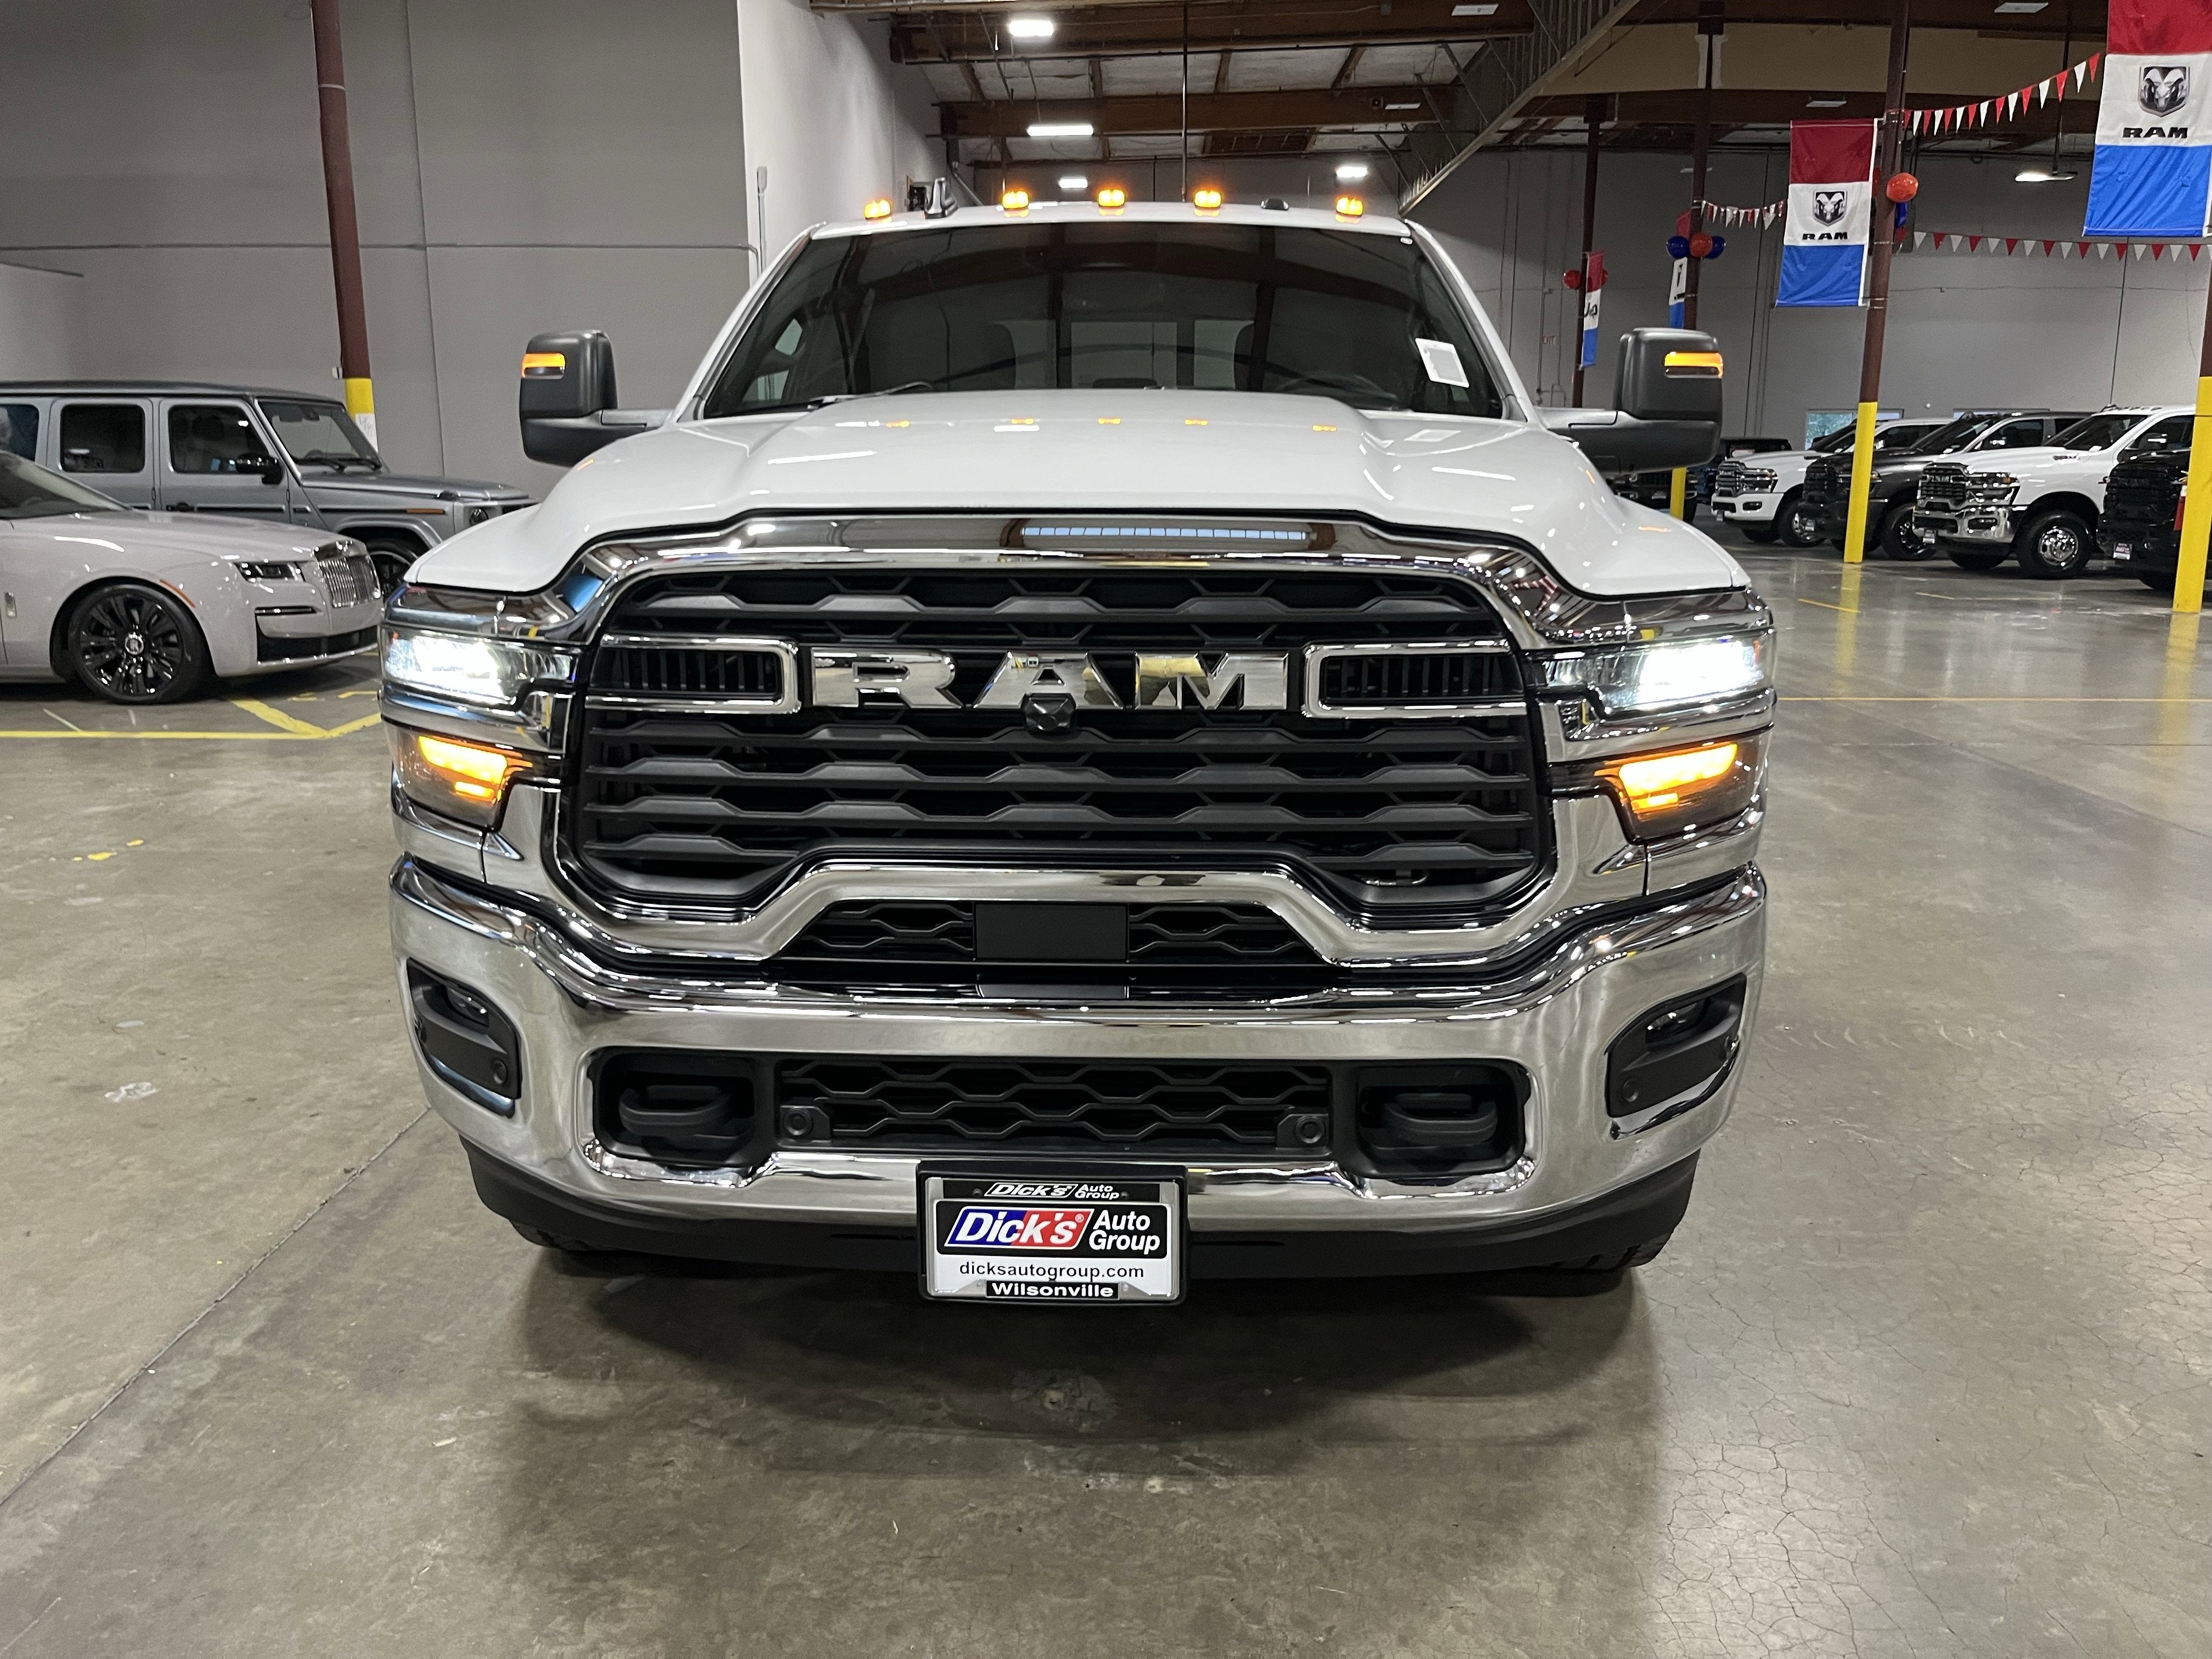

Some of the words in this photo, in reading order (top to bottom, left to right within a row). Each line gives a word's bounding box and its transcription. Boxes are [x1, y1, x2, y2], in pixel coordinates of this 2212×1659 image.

[2122, 127, 2188, 139] RAM
[1802, 232, 1848, 240] RAM
[811, 646, 1289, 710] RAM
[1075, 1191, 1119, 1200] Group
[1080, 1184, 1113, 1192] Auto
[955, 1211, 1076, 1244] Dick's
[1093, 1210, 1150, 1231] Auto
[1088, 1231, 1160, 1255] Group
[960, 1261, 1144, 1281] dicksautogroup.com
[992, 1282, 1114, 1297] Wilsonville
